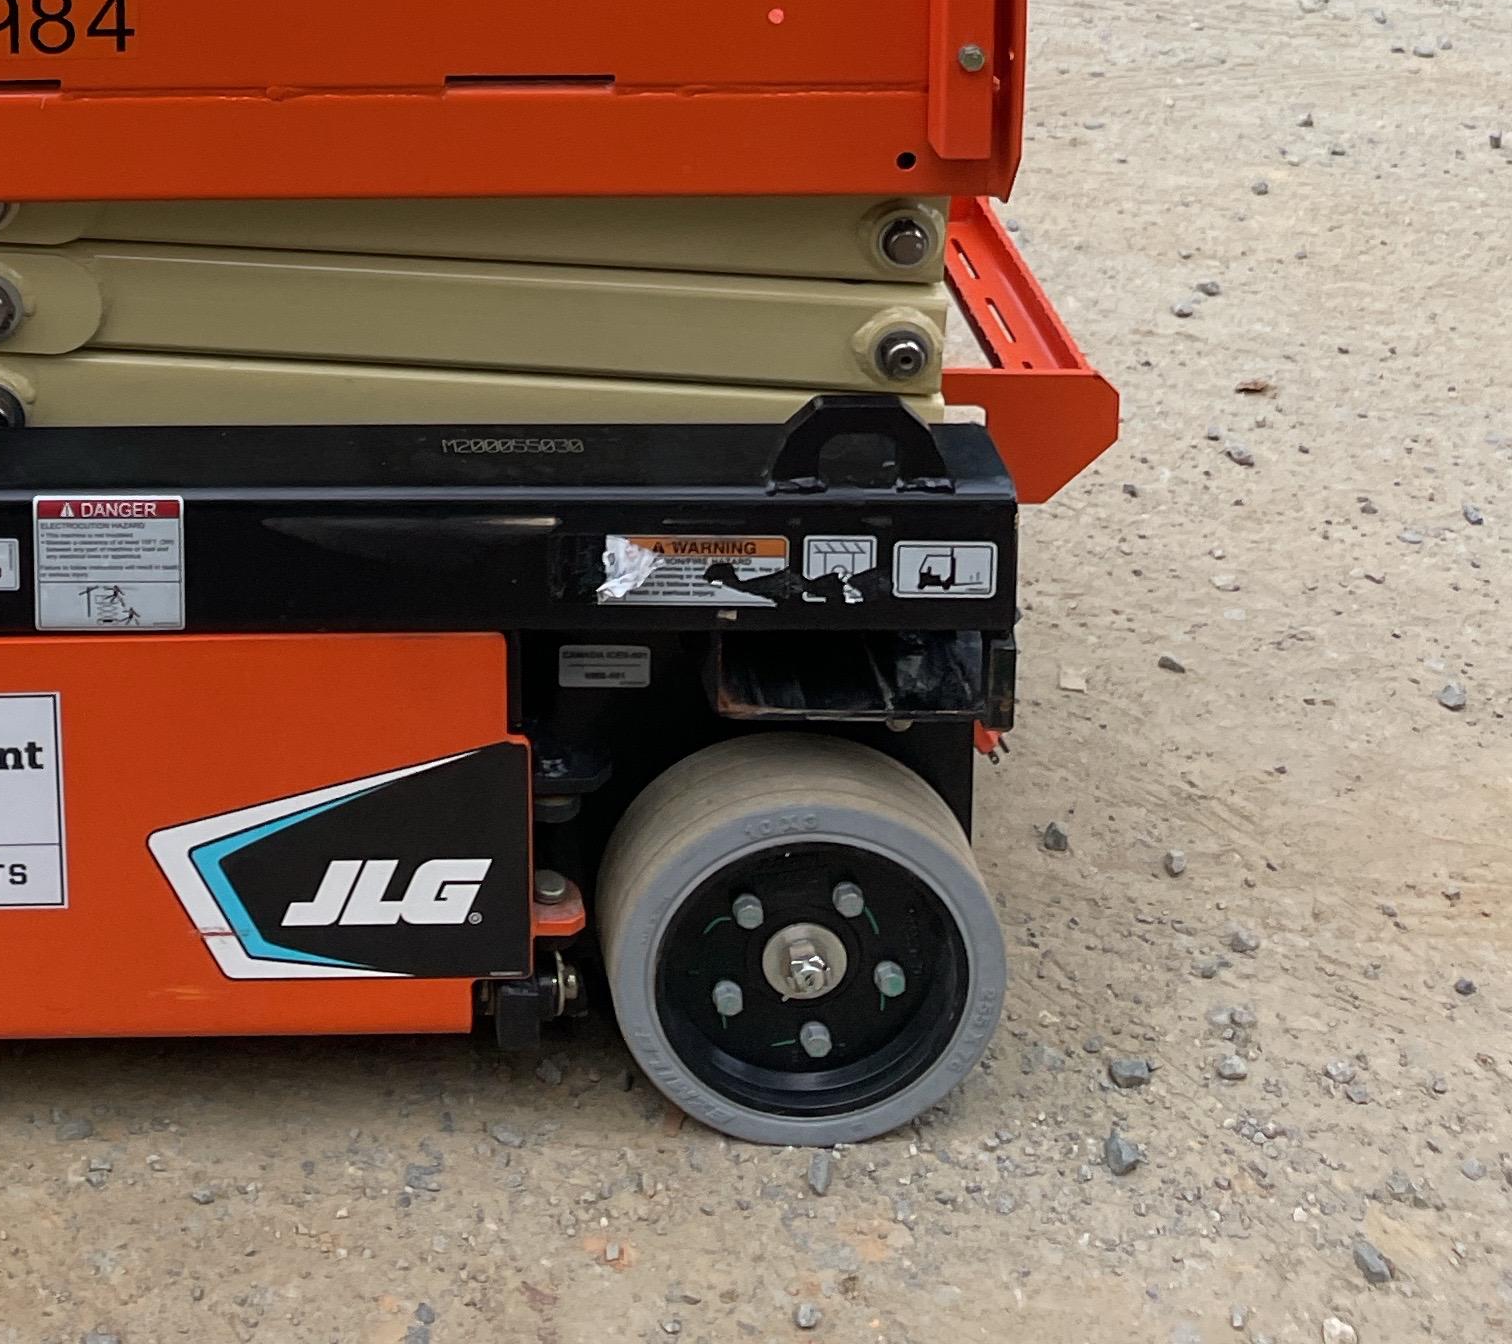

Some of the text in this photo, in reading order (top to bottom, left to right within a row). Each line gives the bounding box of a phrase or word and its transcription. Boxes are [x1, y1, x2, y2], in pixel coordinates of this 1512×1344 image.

[80, 502, 157, 518] DANGER
[672, 541, 757, 555] WARNING
[281, 858, 492, 926] JLG
